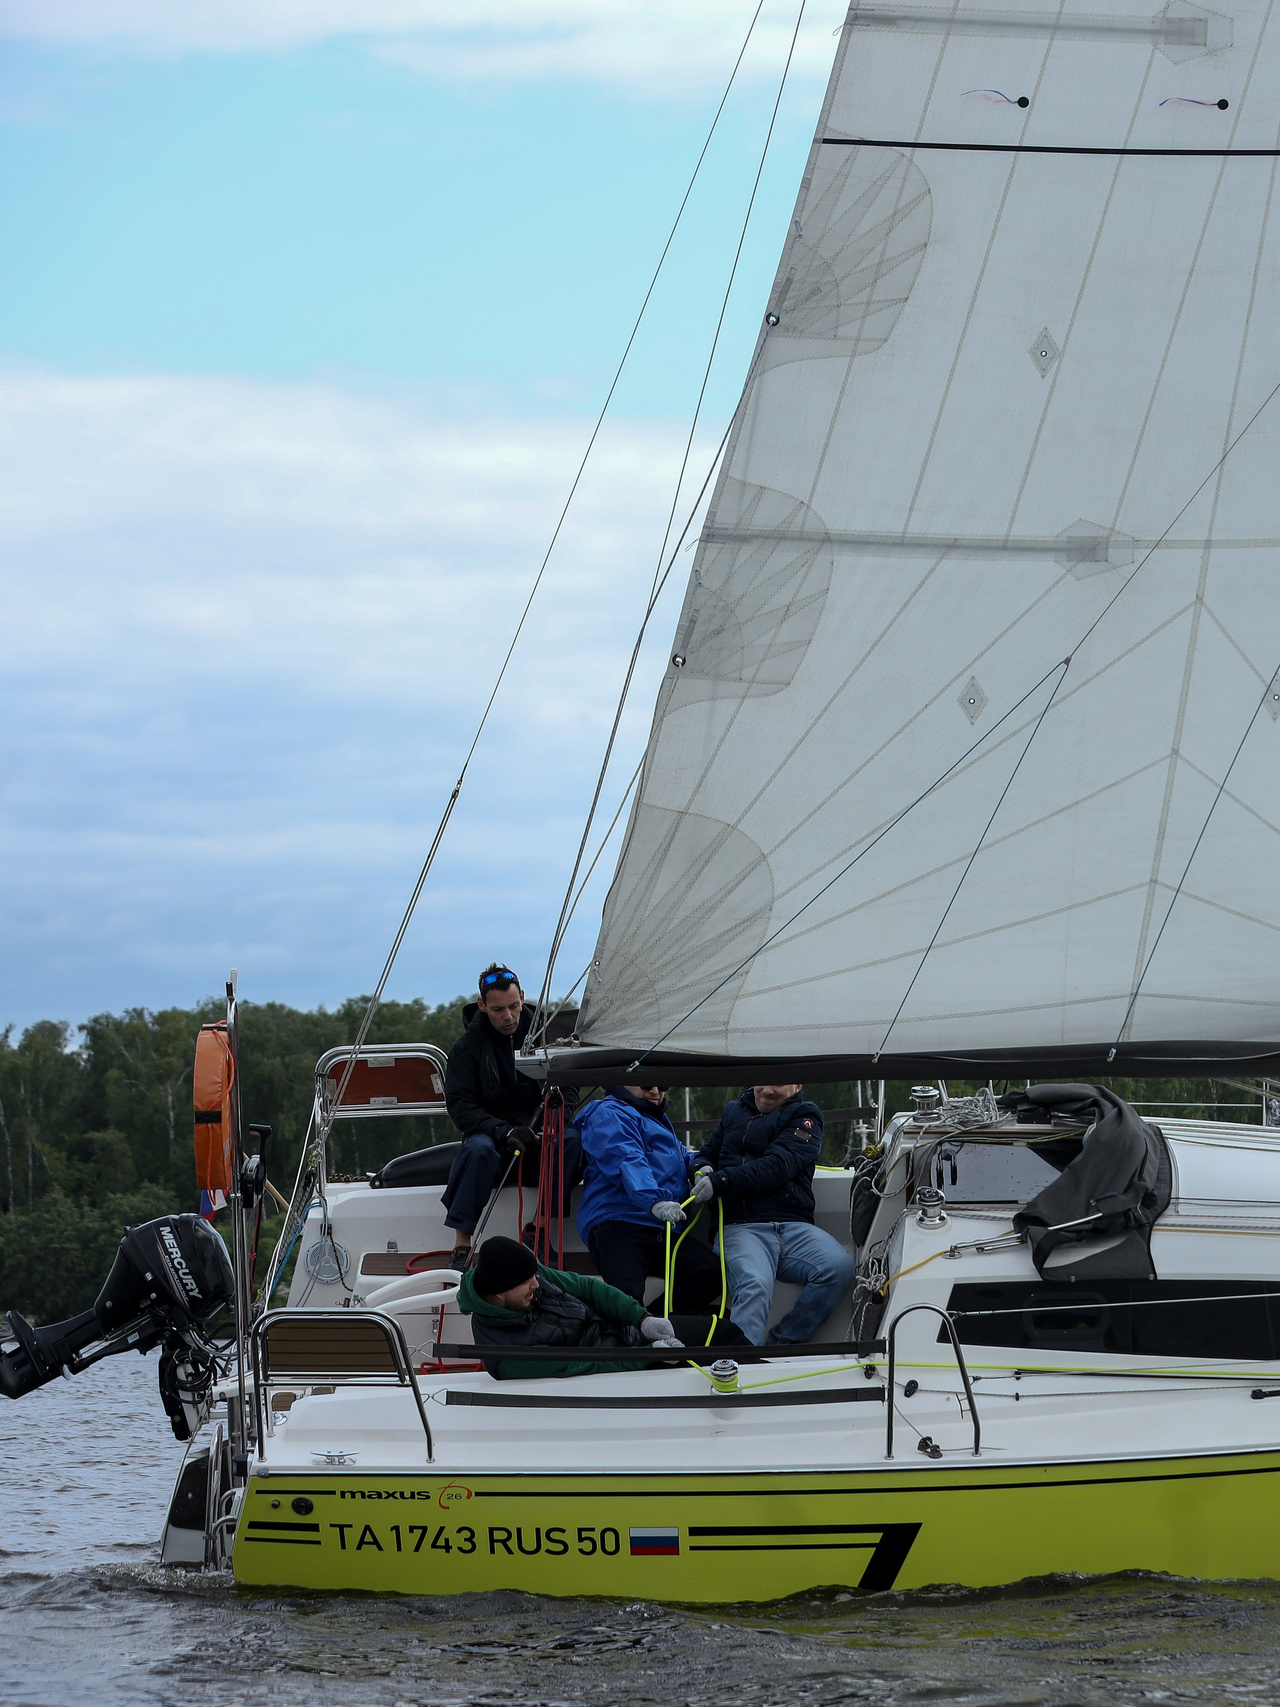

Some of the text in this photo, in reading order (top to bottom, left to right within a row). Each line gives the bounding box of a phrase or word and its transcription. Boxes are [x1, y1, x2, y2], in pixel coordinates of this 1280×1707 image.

[160, 1226, 203, 1299] MERCURY
[339, 1490, 431, 1500] maxus
[329, 1523, 620, 1556] TA 1743 RUS 50
